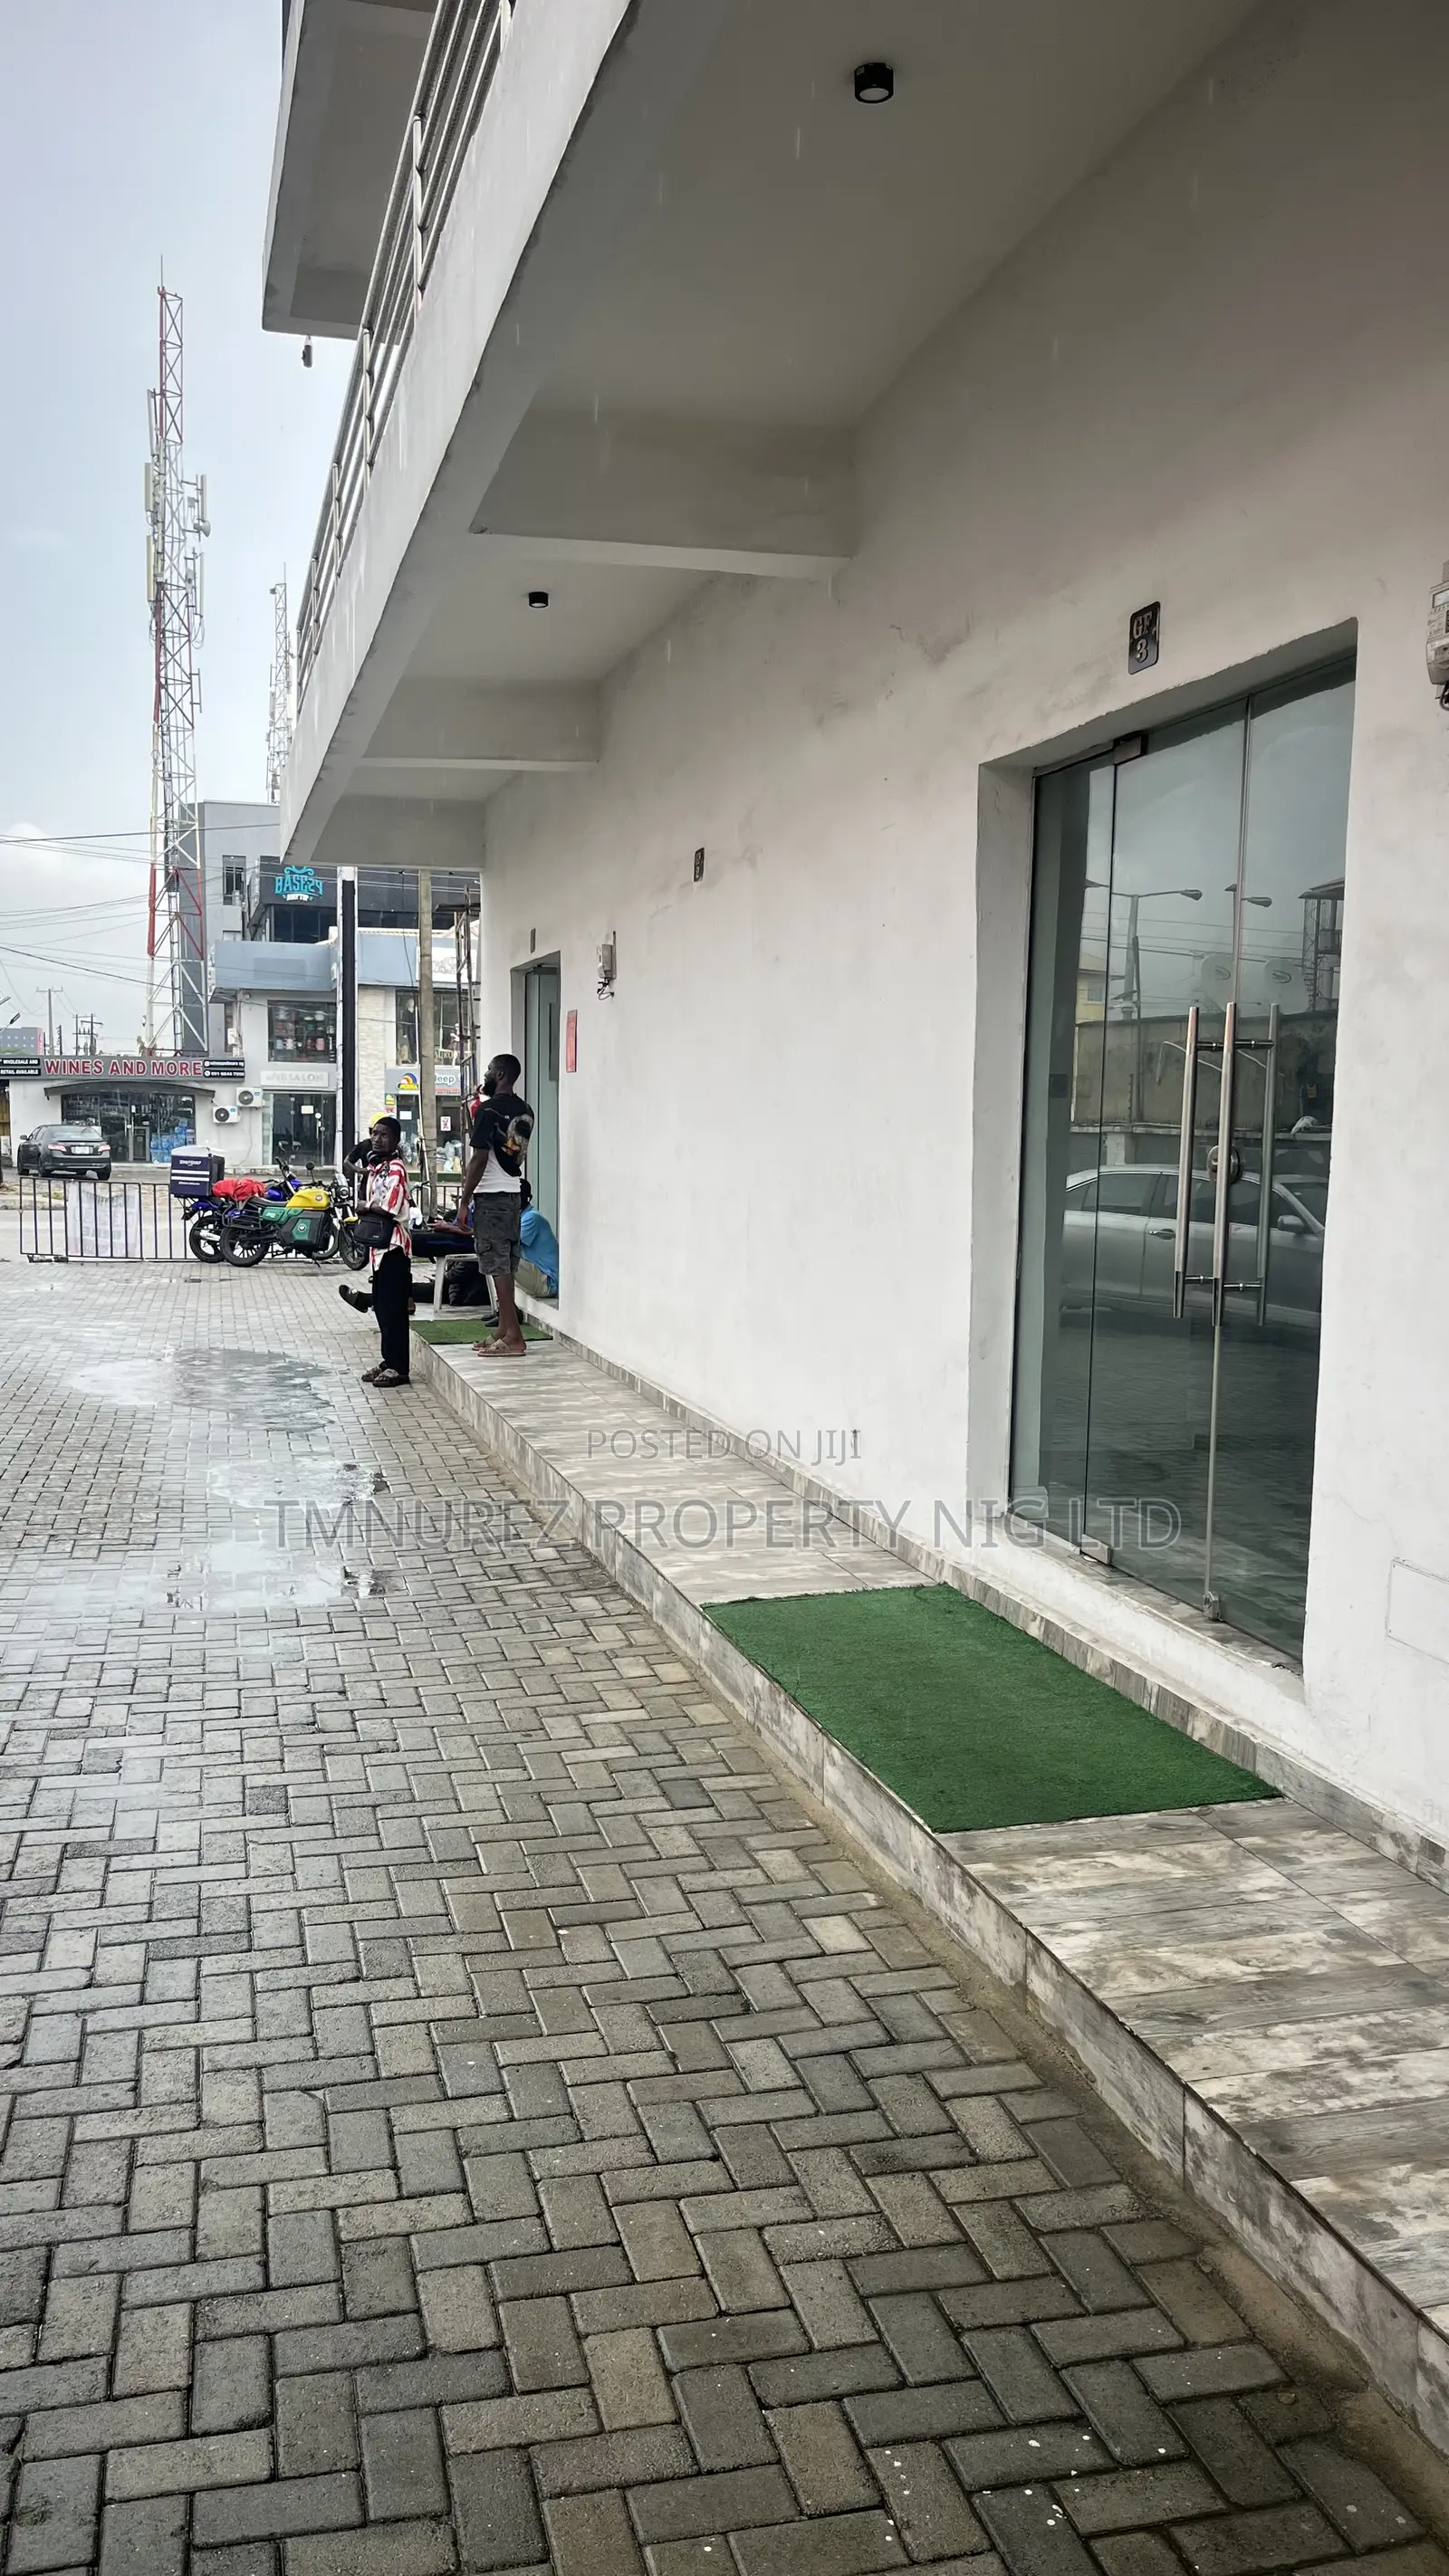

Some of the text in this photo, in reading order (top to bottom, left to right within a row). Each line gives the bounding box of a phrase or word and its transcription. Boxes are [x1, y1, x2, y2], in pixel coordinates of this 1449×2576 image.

[1133, 611, 1153, 639] GF
[1136, 638, 1148, 663] 3
[44, 1058, 203, 1077] WINES AND MORE
